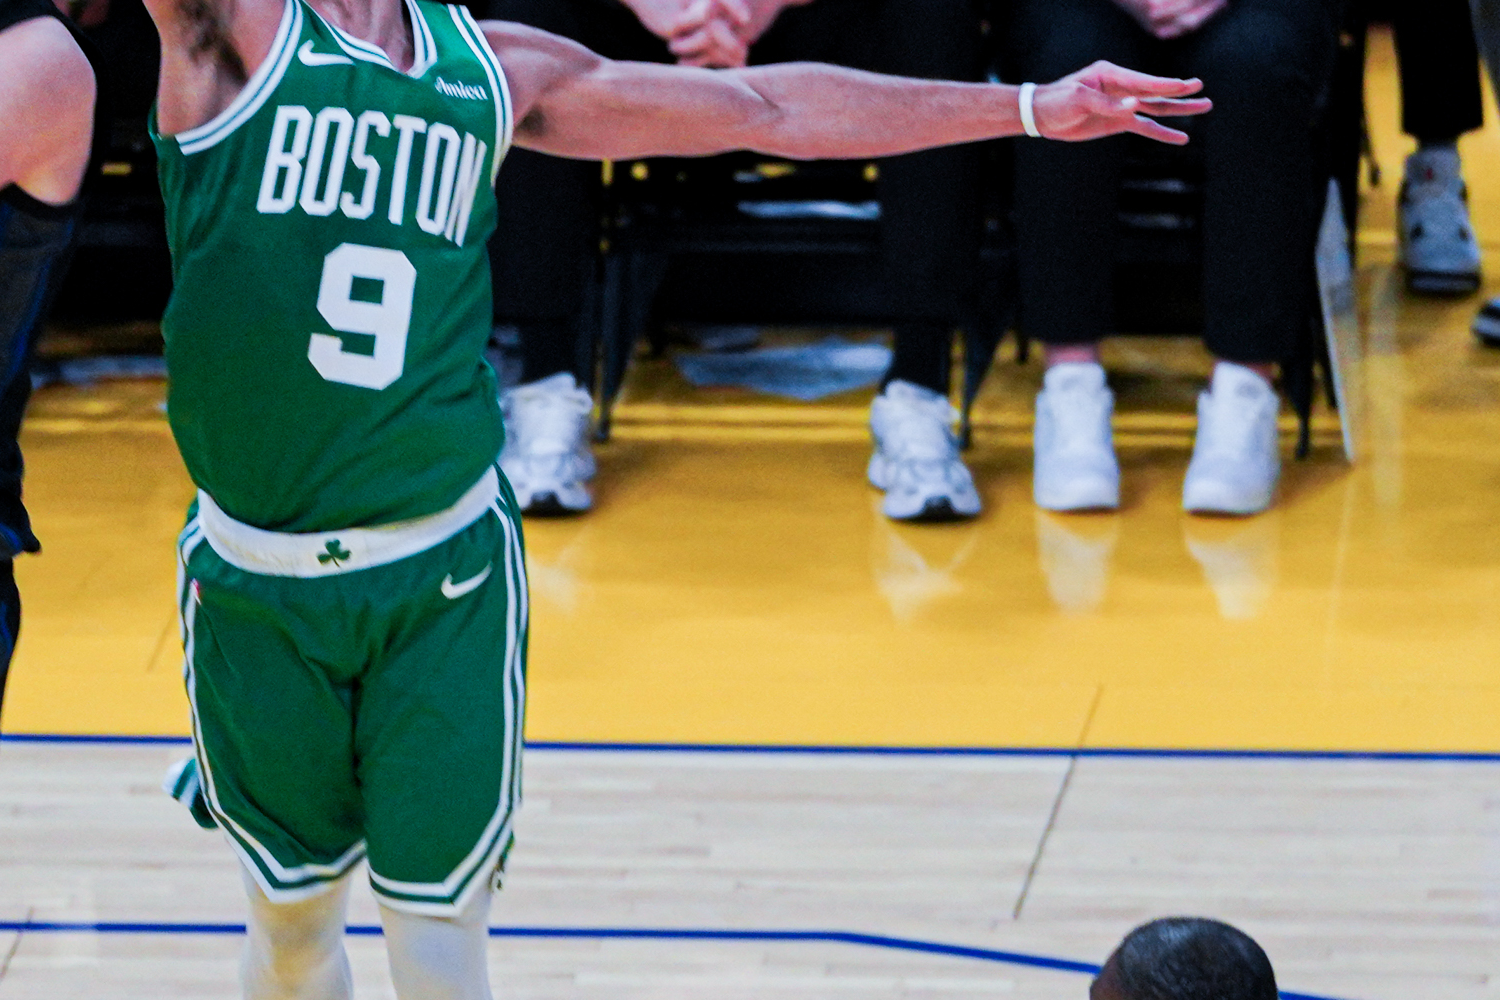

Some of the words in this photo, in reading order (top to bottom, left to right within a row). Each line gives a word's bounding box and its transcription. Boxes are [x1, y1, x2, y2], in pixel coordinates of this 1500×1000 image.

[433, 75, 489, 101] Amica
[256, 104, 488, 249] BOSTON
[307, 241, 418, 391] 9
